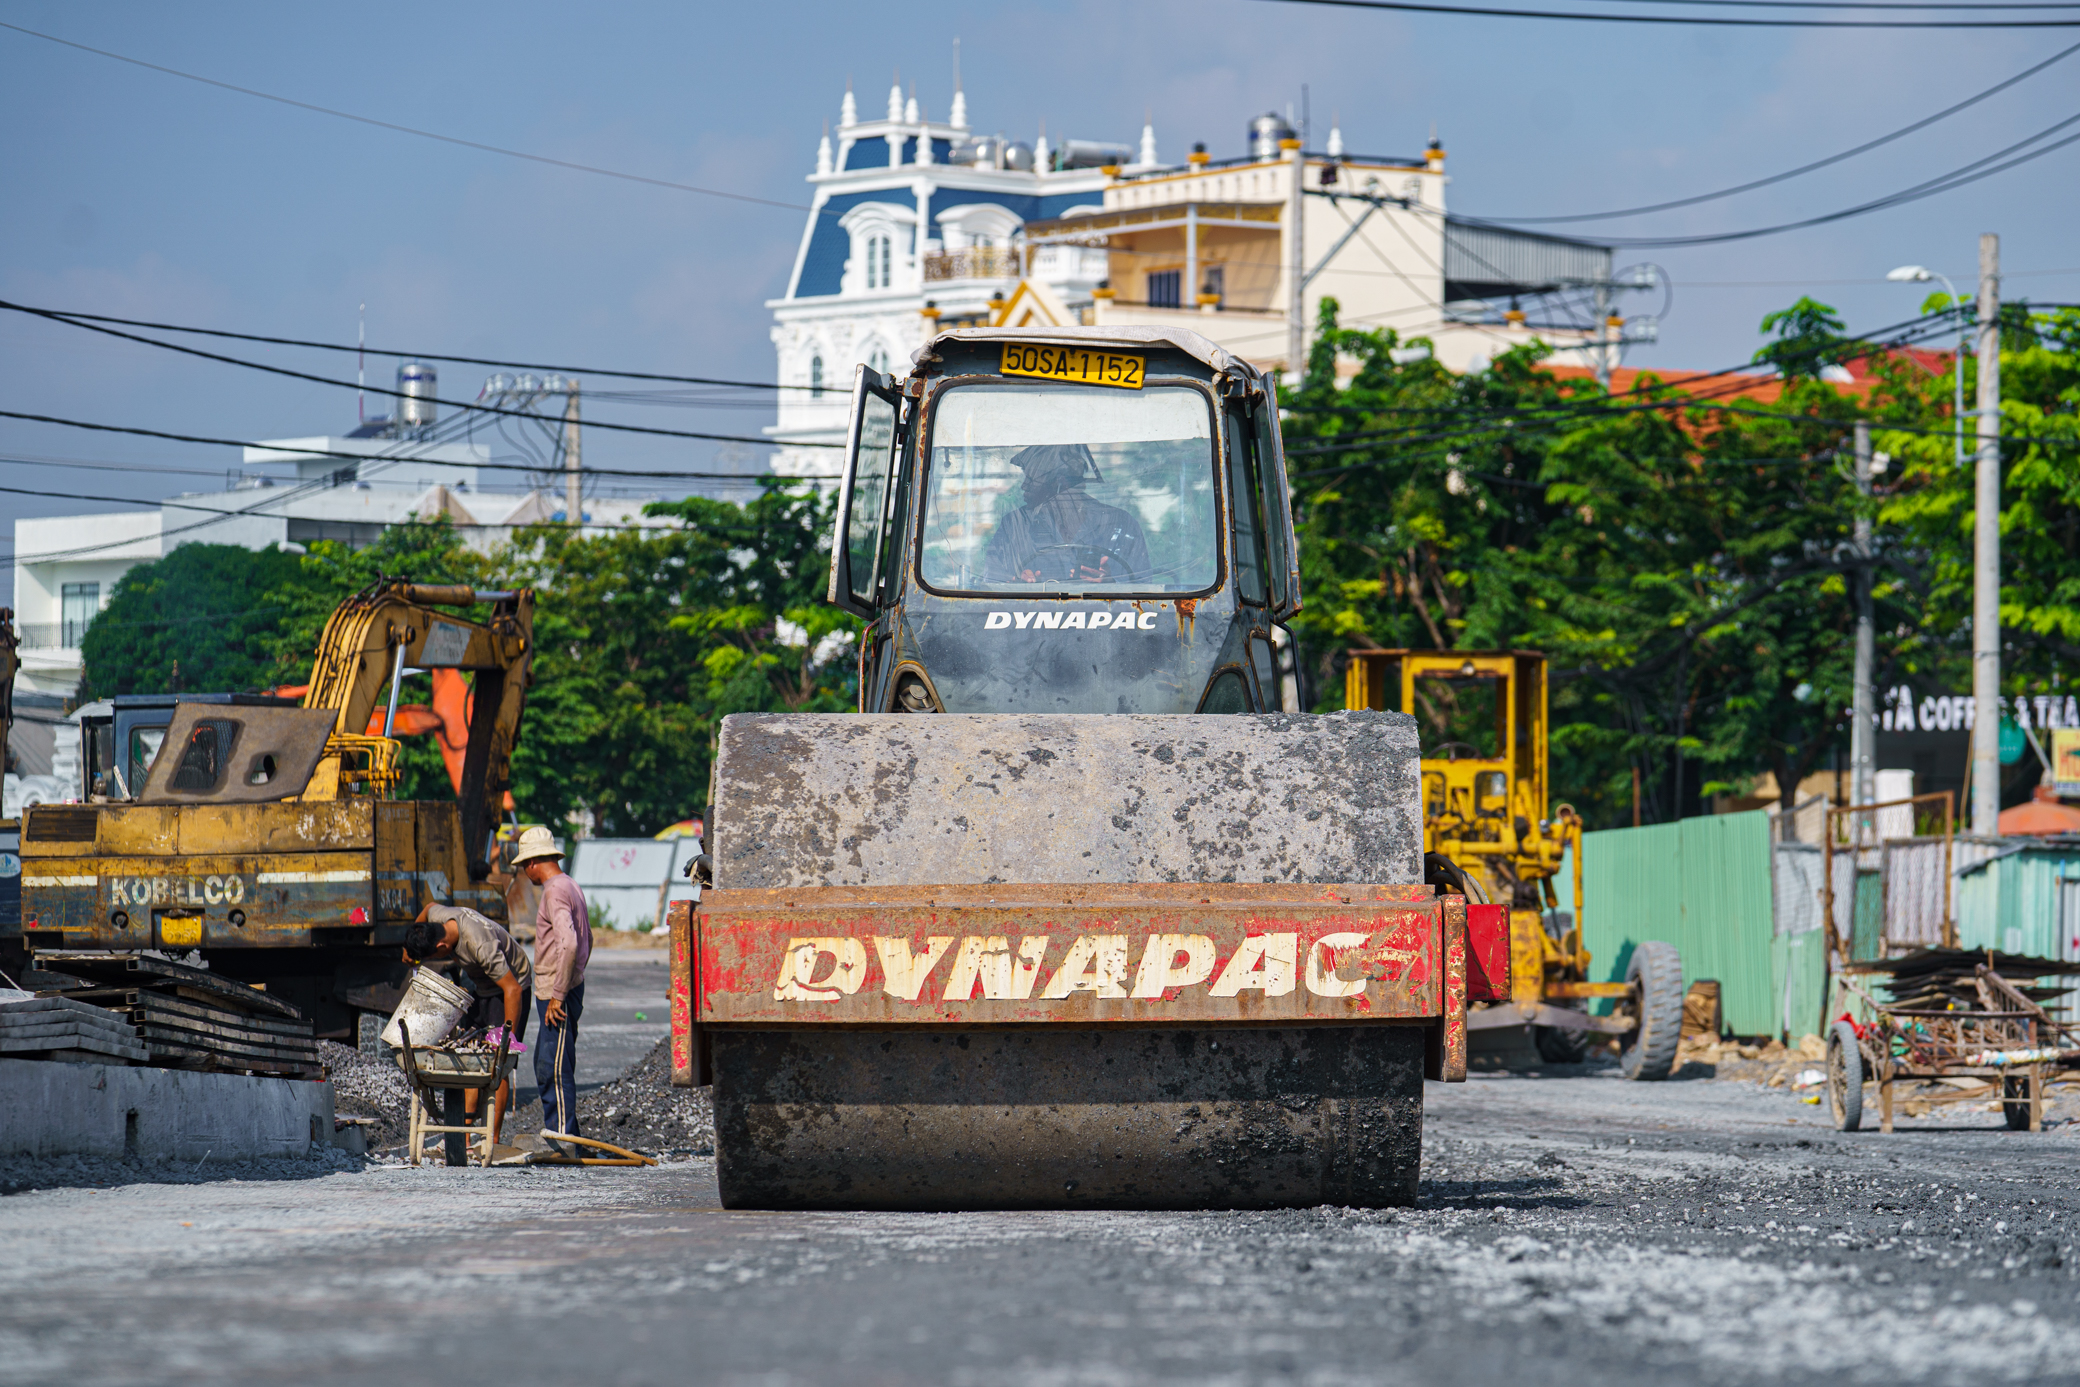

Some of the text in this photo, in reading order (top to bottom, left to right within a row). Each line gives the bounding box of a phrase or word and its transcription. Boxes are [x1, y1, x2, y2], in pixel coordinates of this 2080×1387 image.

[983, 611, 1158, 630] DYNAPAC
[2032, 694, 2080, 730] TEA
[111, 874, 245, 905] KOBELCO
[773, 932, 1371, 1001] DYNAPAC
